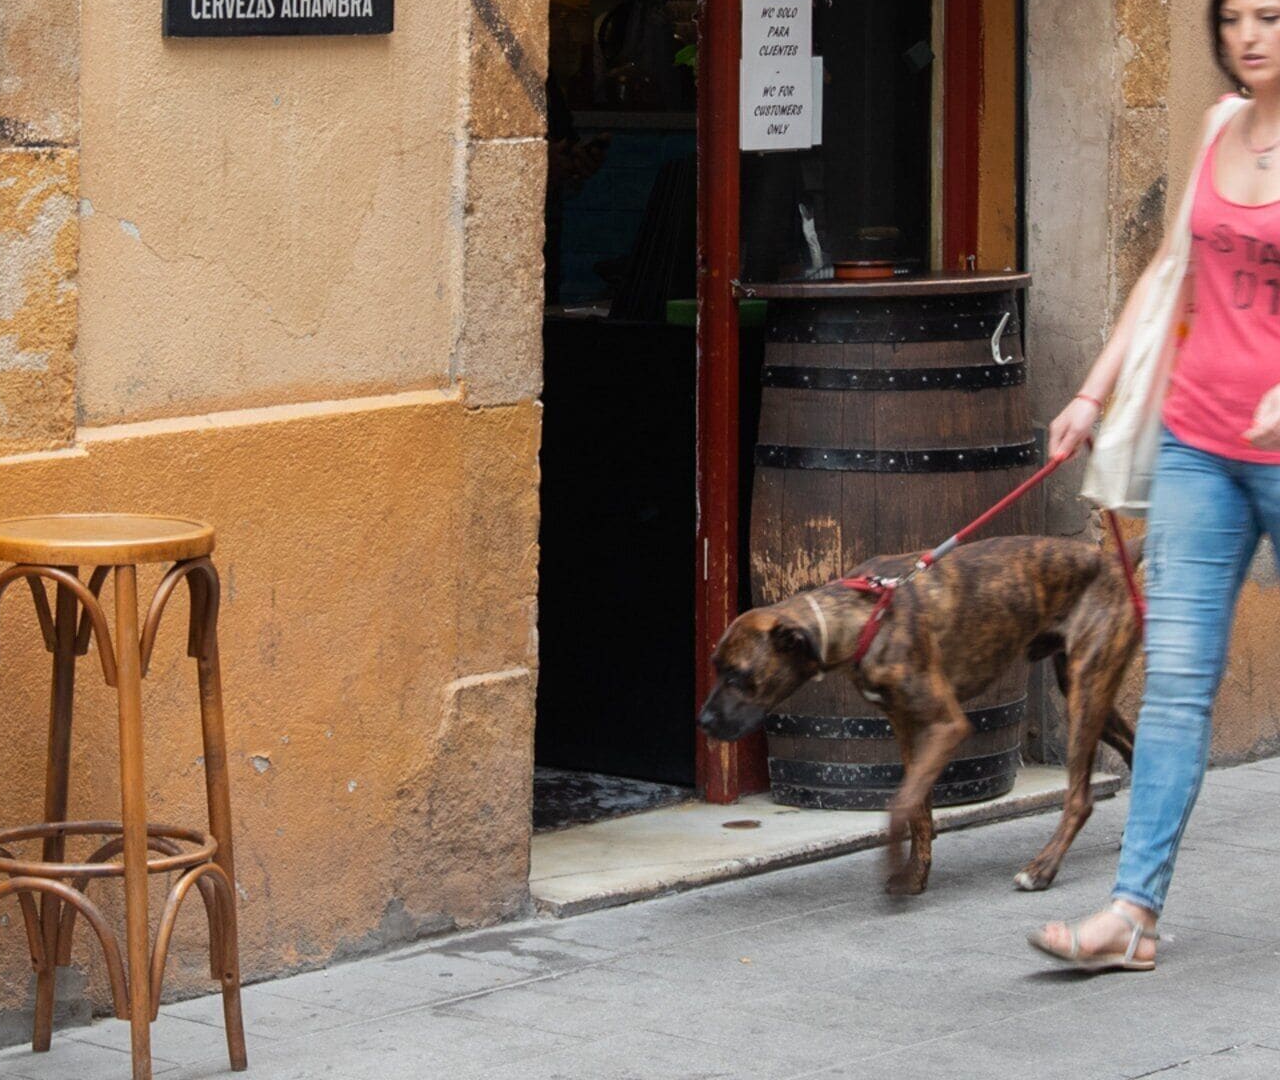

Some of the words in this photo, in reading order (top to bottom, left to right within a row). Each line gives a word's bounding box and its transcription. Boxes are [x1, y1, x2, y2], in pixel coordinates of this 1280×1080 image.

[761, 7, 775, 18] WC
[776, 7, 798, 18] SOLO
[767, 26, 790, 37] PARA
[758, 45, 799, 56] CLIENTES
[762, 85, 777, 97] WC
[778, 85, 795, 97] FOR
[754, 105, 803, 117] CUSTOMERS
[766, 124, 790, 135] ONLY
